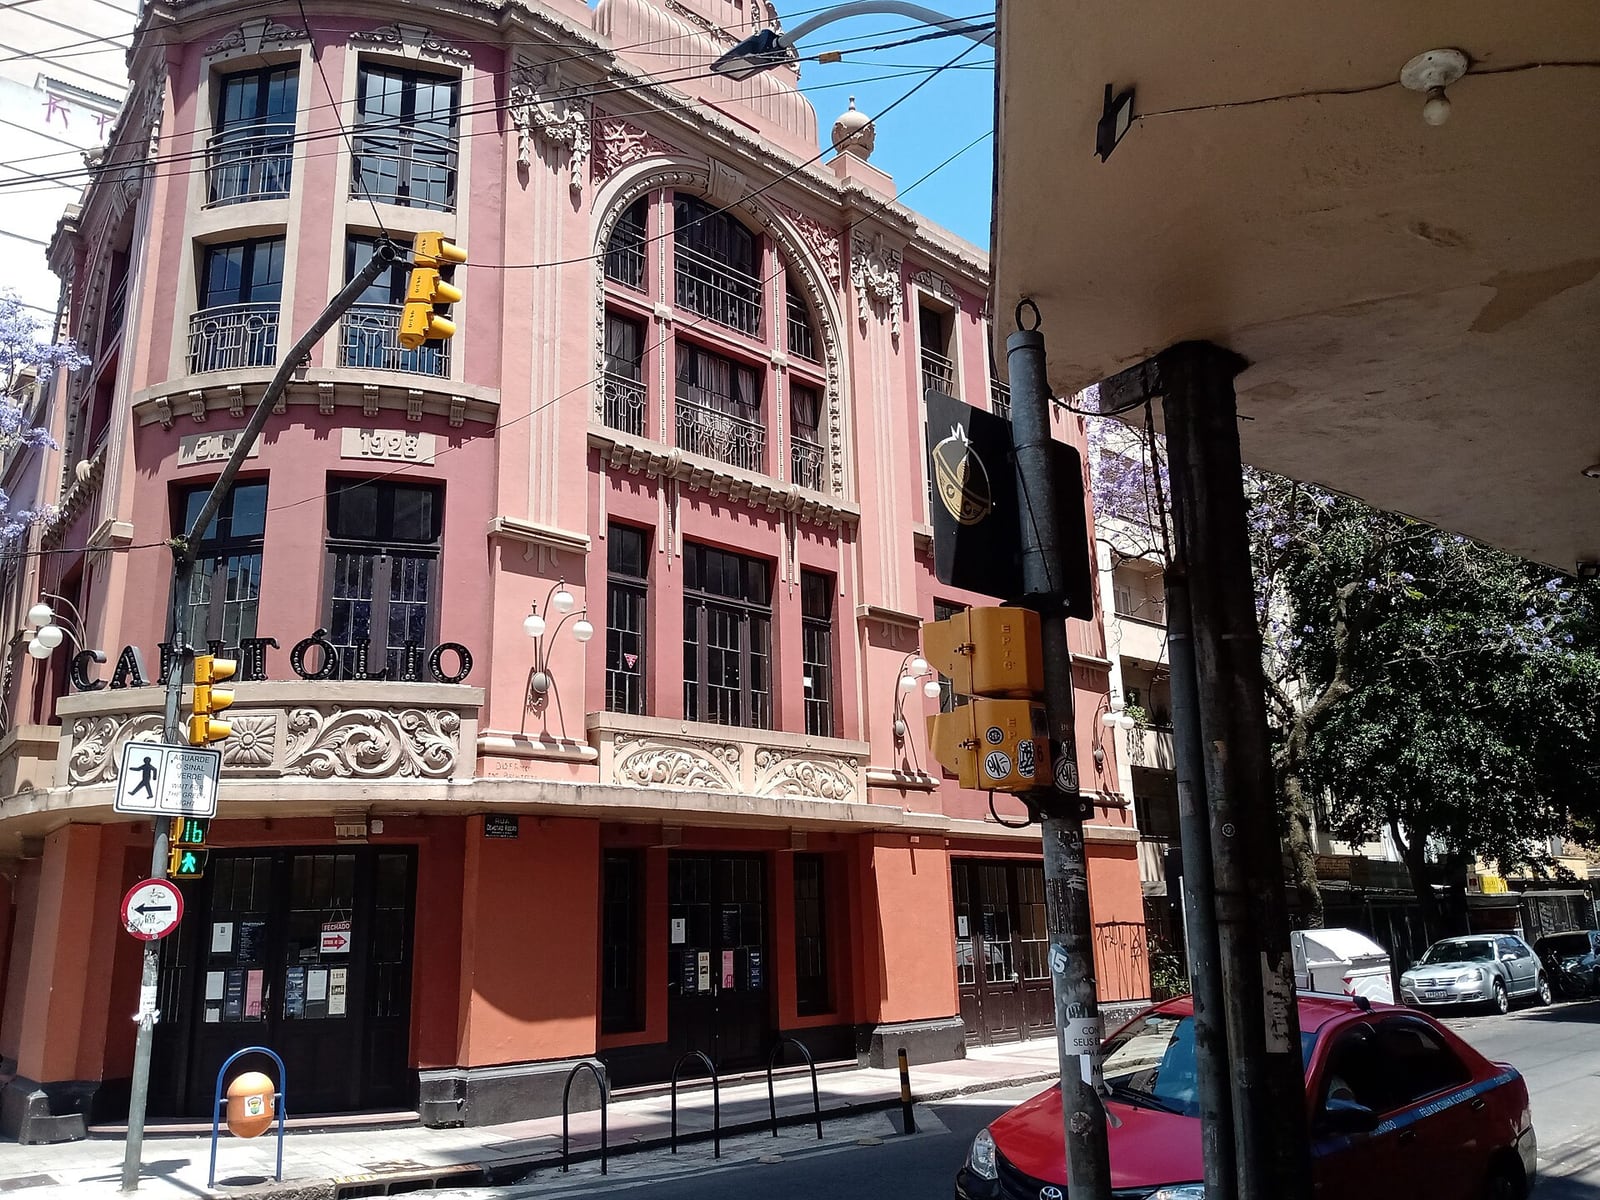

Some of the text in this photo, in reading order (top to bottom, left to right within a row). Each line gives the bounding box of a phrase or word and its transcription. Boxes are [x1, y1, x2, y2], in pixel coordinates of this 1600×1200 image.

[360, 432, 419, 459] 1928
[173, 754, 211, 764] AGUARDE
[183, 763, 206, 772] SINAL
[176, 772, 203, 781] VERDE
[185, 820, 203, 844] 16
[323, 923, 351, 931] FECHADO
[1073, 1038, 1094, 1047] SEUS
